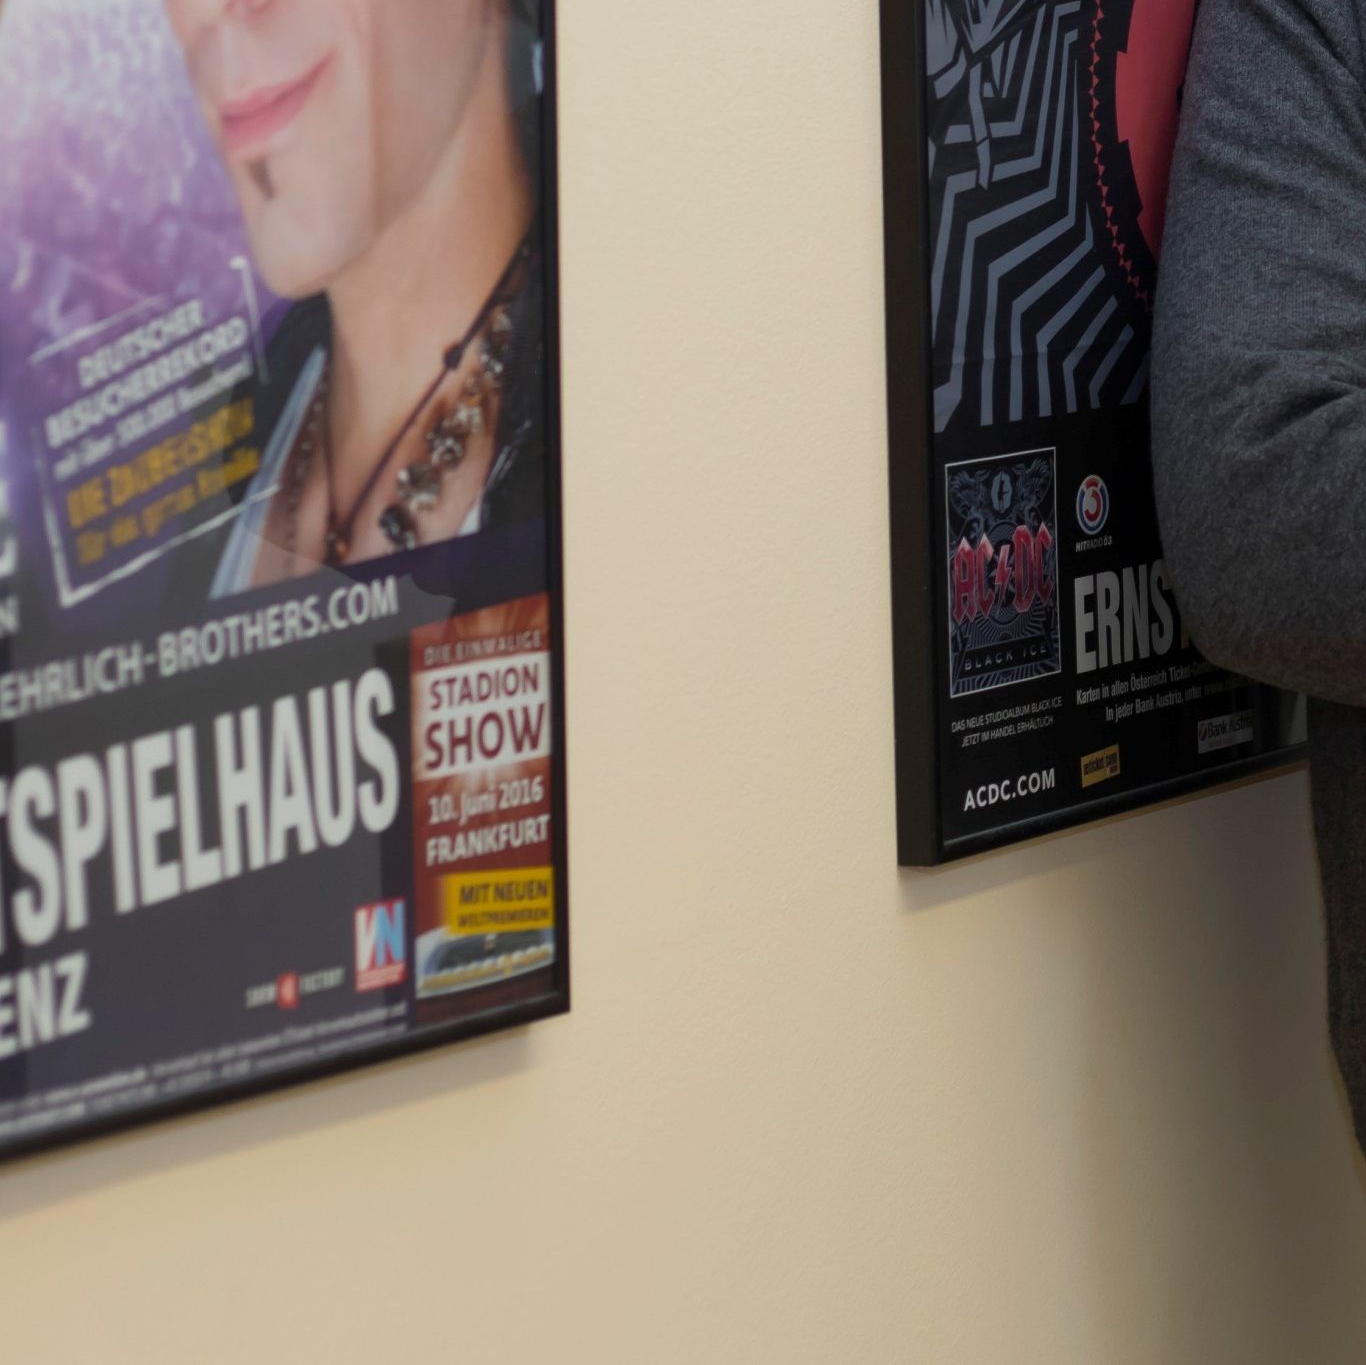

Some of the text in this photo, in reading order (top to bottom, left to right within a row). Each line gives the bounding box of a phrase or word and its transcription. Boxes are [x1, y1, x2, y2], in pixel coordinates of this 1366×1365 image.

[1074, 559, 1175, 675] ERNS
[0, 575, 399, 720] EHRLICH-BROTHERS.COM
[424, 629, 542, 667] DIE EINMALIGE
[964, 641, 1048, 671] BLACK ICE
[430, 663, 540, 711] STADION
[1076, 688, 1100, 706] Karten
[1101, 683, 1110, 699] in
[1110, 680, 1129, 697] allen
[1130, 672, 1167, 692] Österreich
[951, 696, 1063, 733] DAS NEUE STUDIOALBUM BLACK ICE
[1115, 702, 1134, 722] jeder
[1135, 698, 1155, 715] Bank
[1208, 718, 1228, 738] Bank
[425, 702, 545, 771] SHOW
[961, 733, 981, 748] JETZT
[981, 731, 990, 742] IM
[990, 724, 1017, 740] HANDEL
[0, 667, 400, 946] SPIELHAUS
[428, 793, 457, 826] 10.
[500, 775, 543, 810] 2016
[963, 768, 1055, 812] ACDC.COM
[425, 814, 551, 867] FRANKFURT
[459, 878, 548, 906] MIT NEUEN
